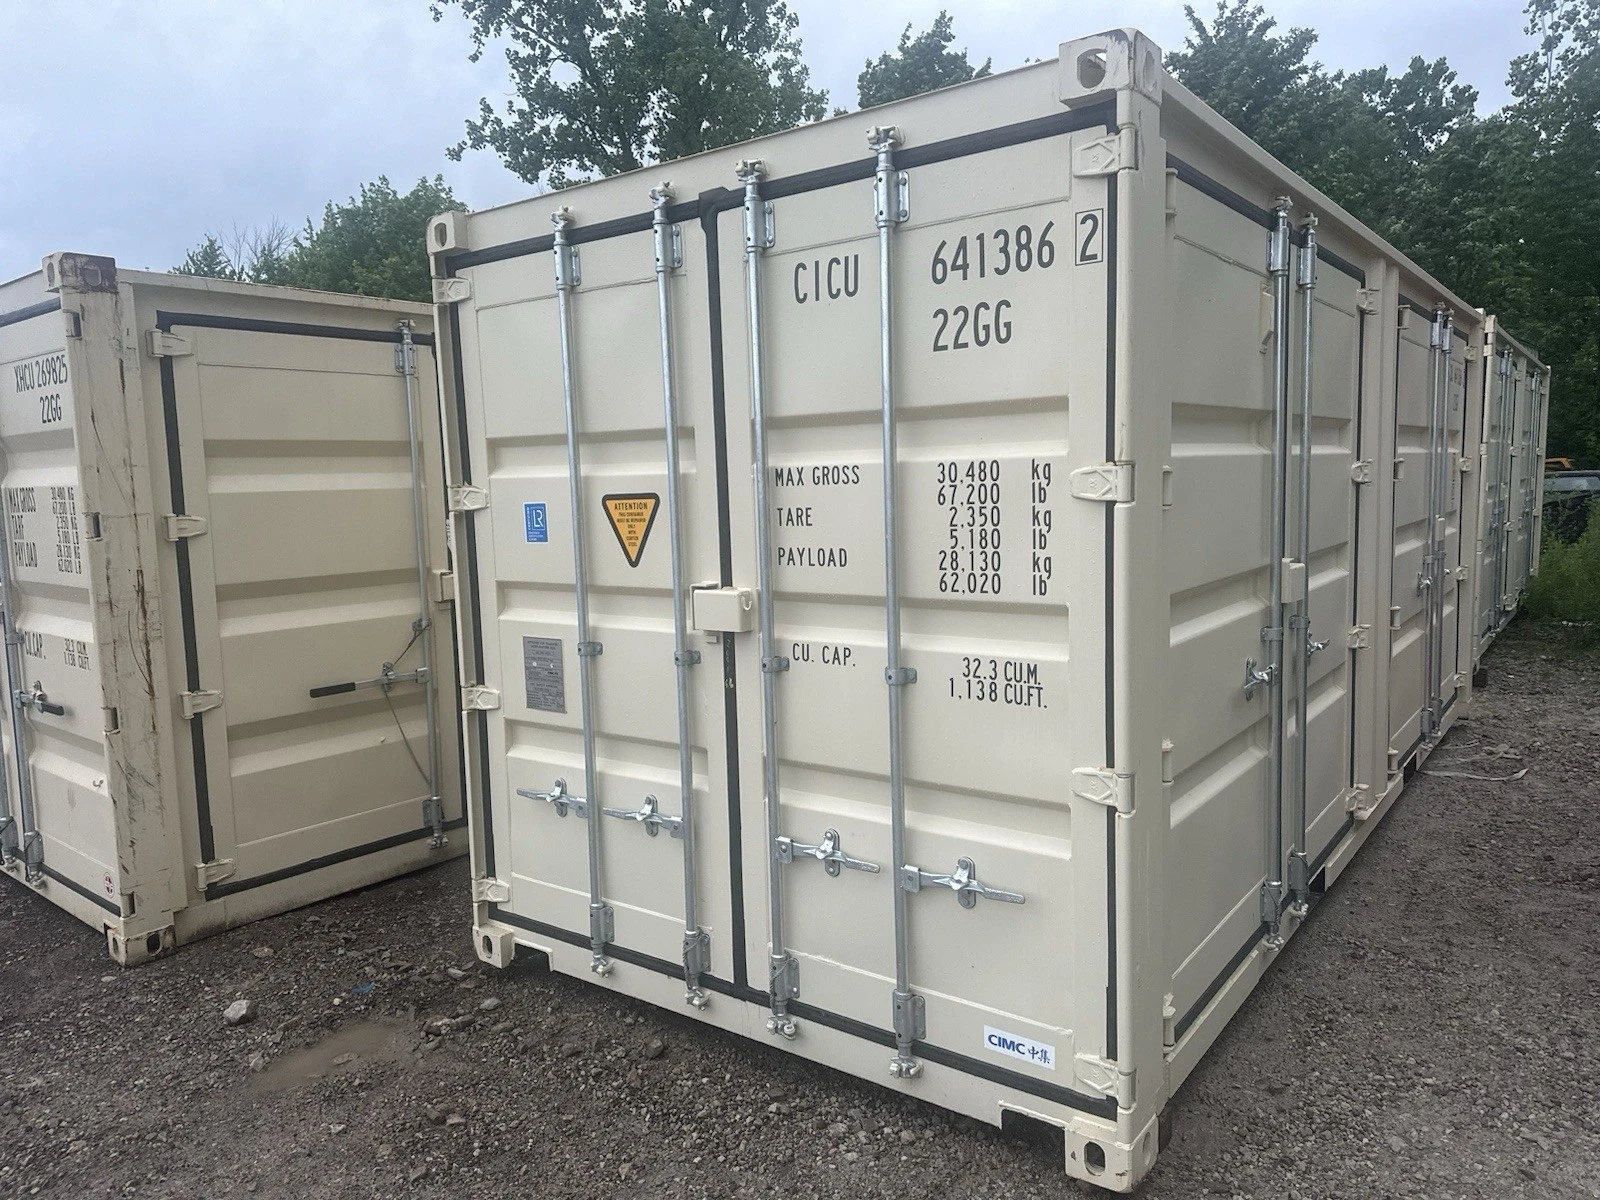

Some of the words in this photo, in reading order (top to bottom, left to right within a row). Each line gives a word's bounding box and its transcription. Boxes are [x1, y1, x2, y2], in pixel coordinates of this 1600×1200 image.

[794, 254, 859, 304] CICU
[931, 221, 1055, 285] 641386
[1079, 213, 1099, 262] 2
[932, 299, 1012, 352] 22GG
[14, 362, 35, 393] XHCU
[36, 354, 68, 388] 269825
[40, 394, 62, 424] 22GG
[775, 467, 804, 486] MAX
[812, 465, 860, 486] GROSS
[1032, 459, 1051, 486] kg
[614, 502, 648, 510] ATTENTION
[1032, 482, 1046, 504] lb
[777, 507, 813, 527] TARE
[1032, 506, 1051, 533] kg
[1032, 528, 1047, 550] lb
[778, 548, 848, 568] PAYLOAD
[1032, 552, 1052, 580] kg
[1032, 574, 1048, 596] lb
[792, 643, 814, 663] CU.
[822, 646, 856, 667] CAP.
[962, 656, 998, 680] 32.3
[1004, 660, 1041, 685] CU.M.
[1004, 684, 1048, 708] CU.FT.
[988, 1034, 1025, 1055] CIMC
